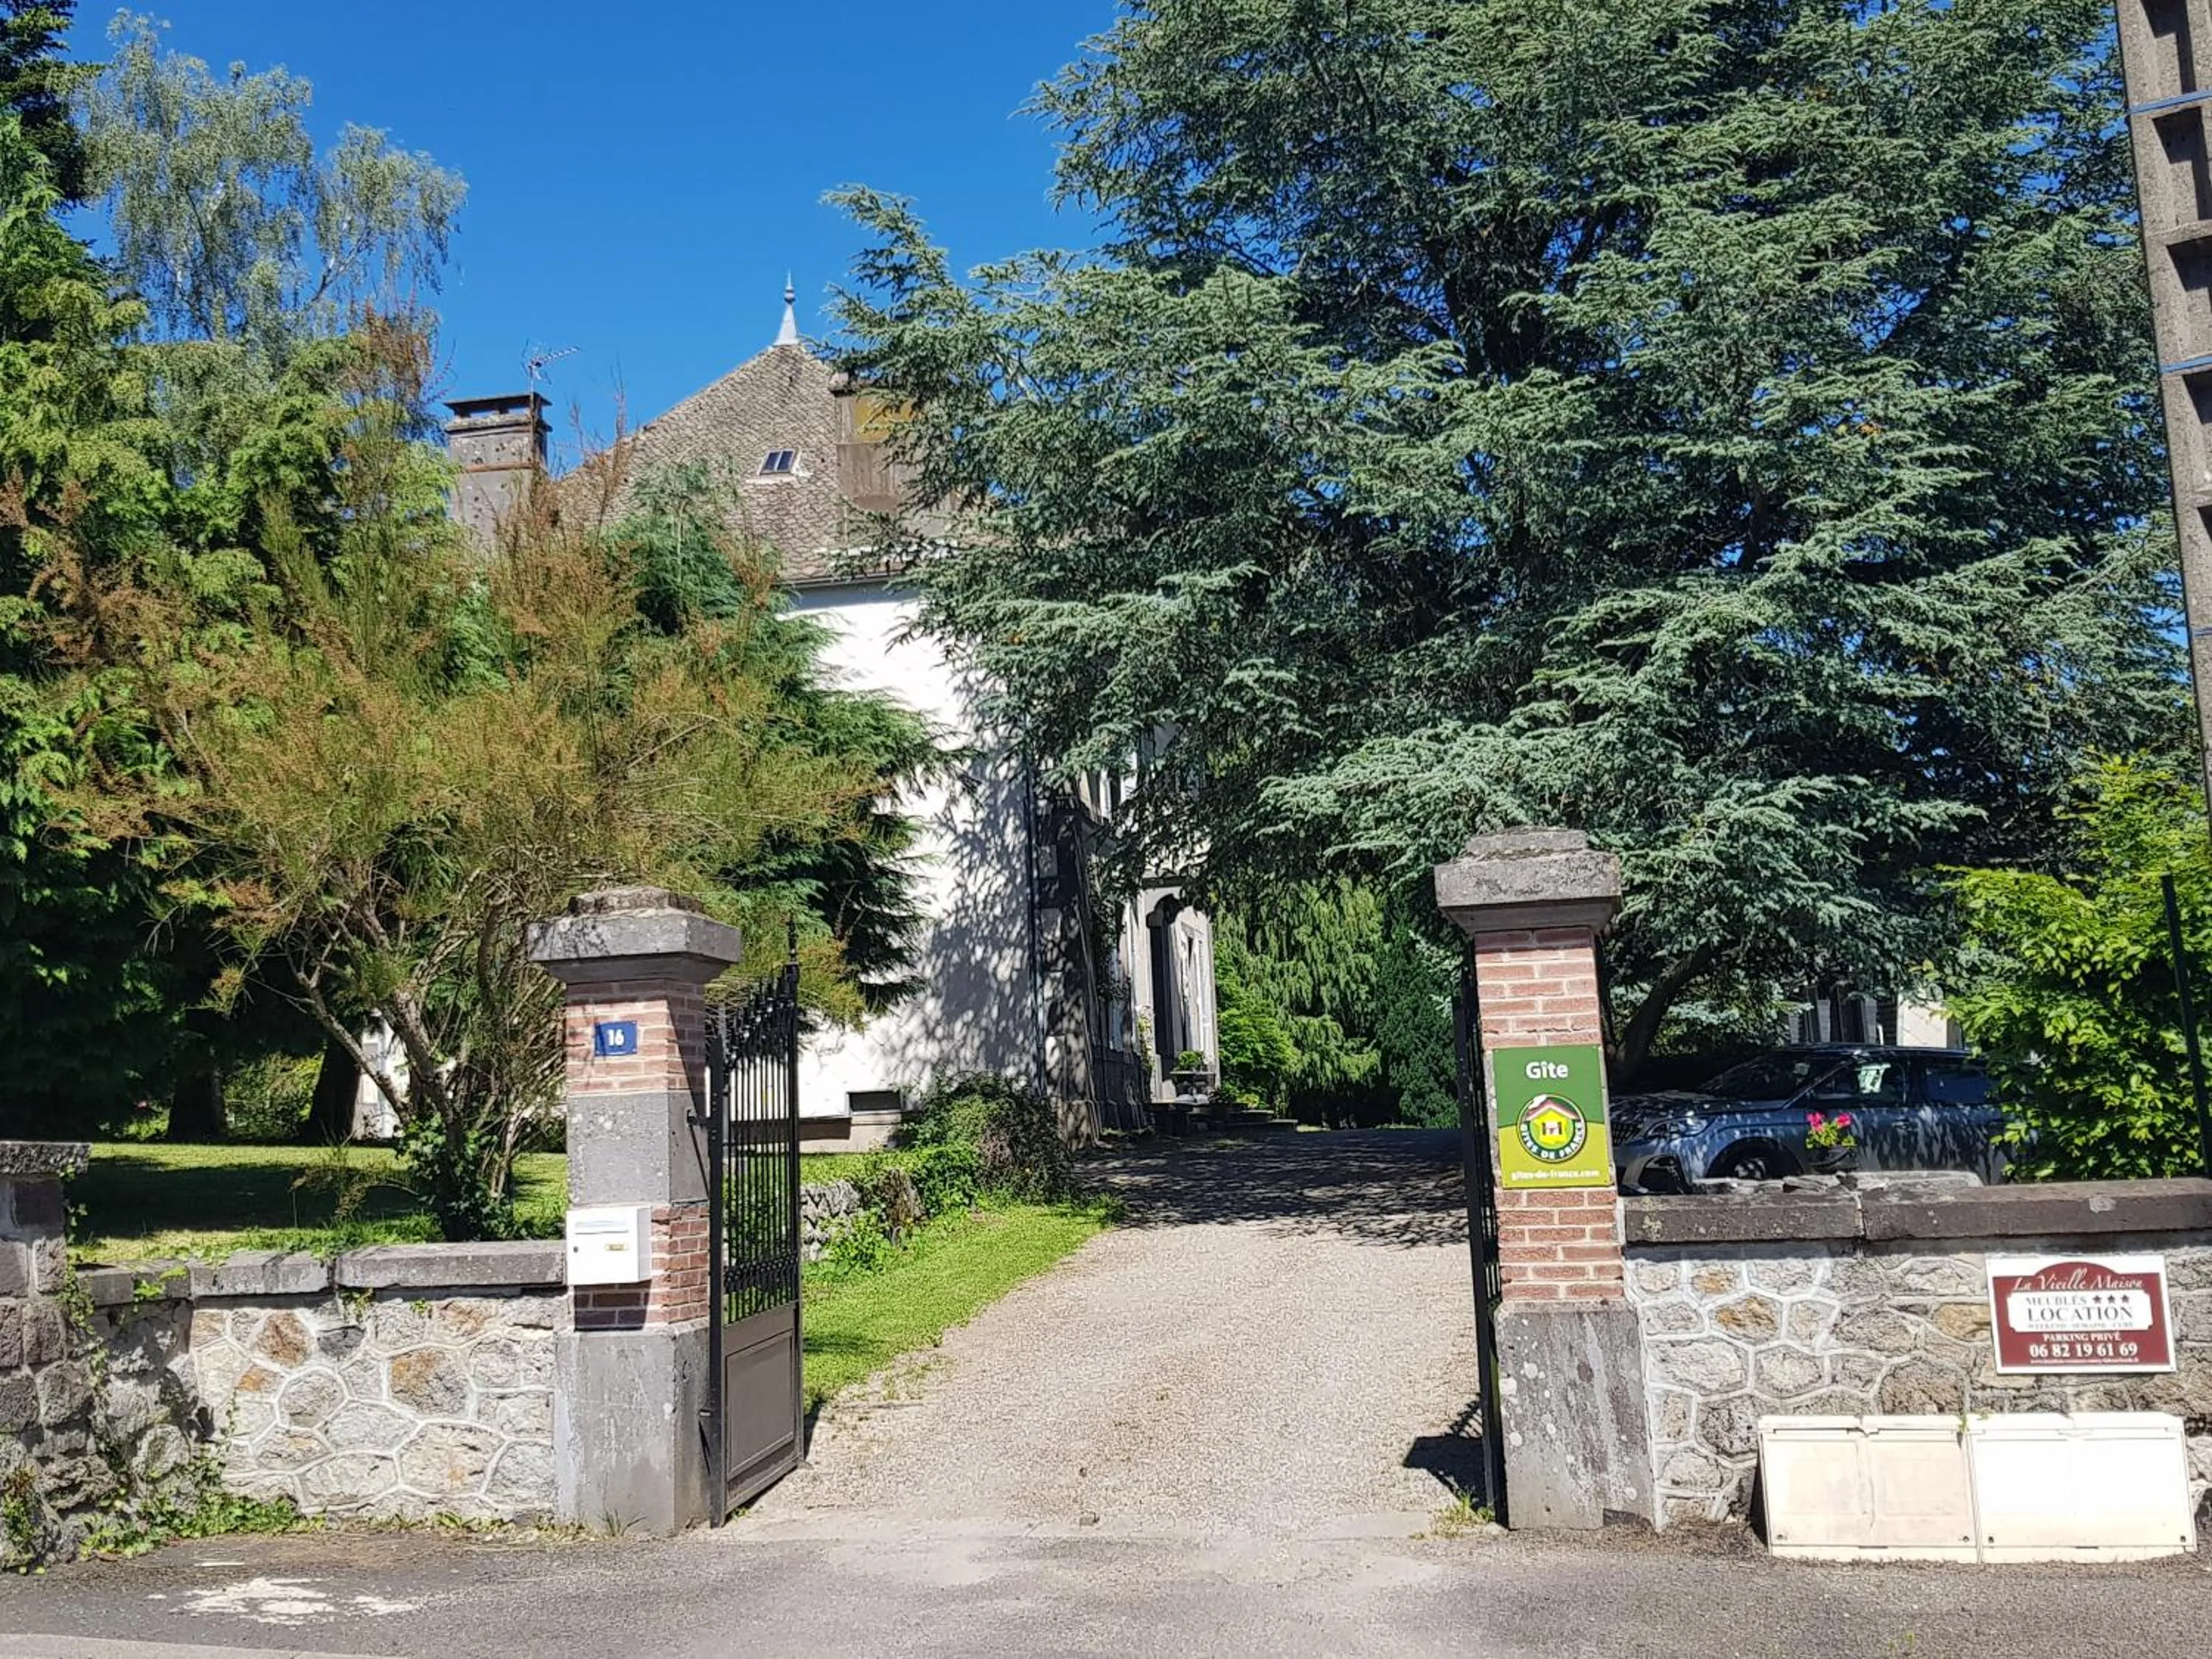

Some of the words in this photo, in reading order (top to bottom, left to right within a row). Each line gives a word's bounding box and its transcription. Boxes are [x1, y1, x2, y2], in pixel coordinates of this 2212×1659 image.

[608, 1029, 625, 1046] 16
[1540, 1150, 1555, 1160] DE
[1559, 1121, 1582, 1158] FRANCE
[2014, 1277, 2031, 1290] La
[2037, 1267, 2087, 1290] Vieille
[2090, 1275, 2143, 1290] Maison
[2026, 1295, 2087, 1304] MEUBLÉS
[2028, 1307, 2133, 1322] LOCATION
[2043, 1333, 2089, 1341] PARKING
[2090, 1331, 2121, 1340] PRIVÉ
[2029, 1343, 2049, 1357] 06
[2052, 1343, 2070, 1357] 82
[2076, 1343, 2093, 1357] 19
[2096, 1342, 2114, 1357] 61
[2119, 1342, 2138, 1356] 69
